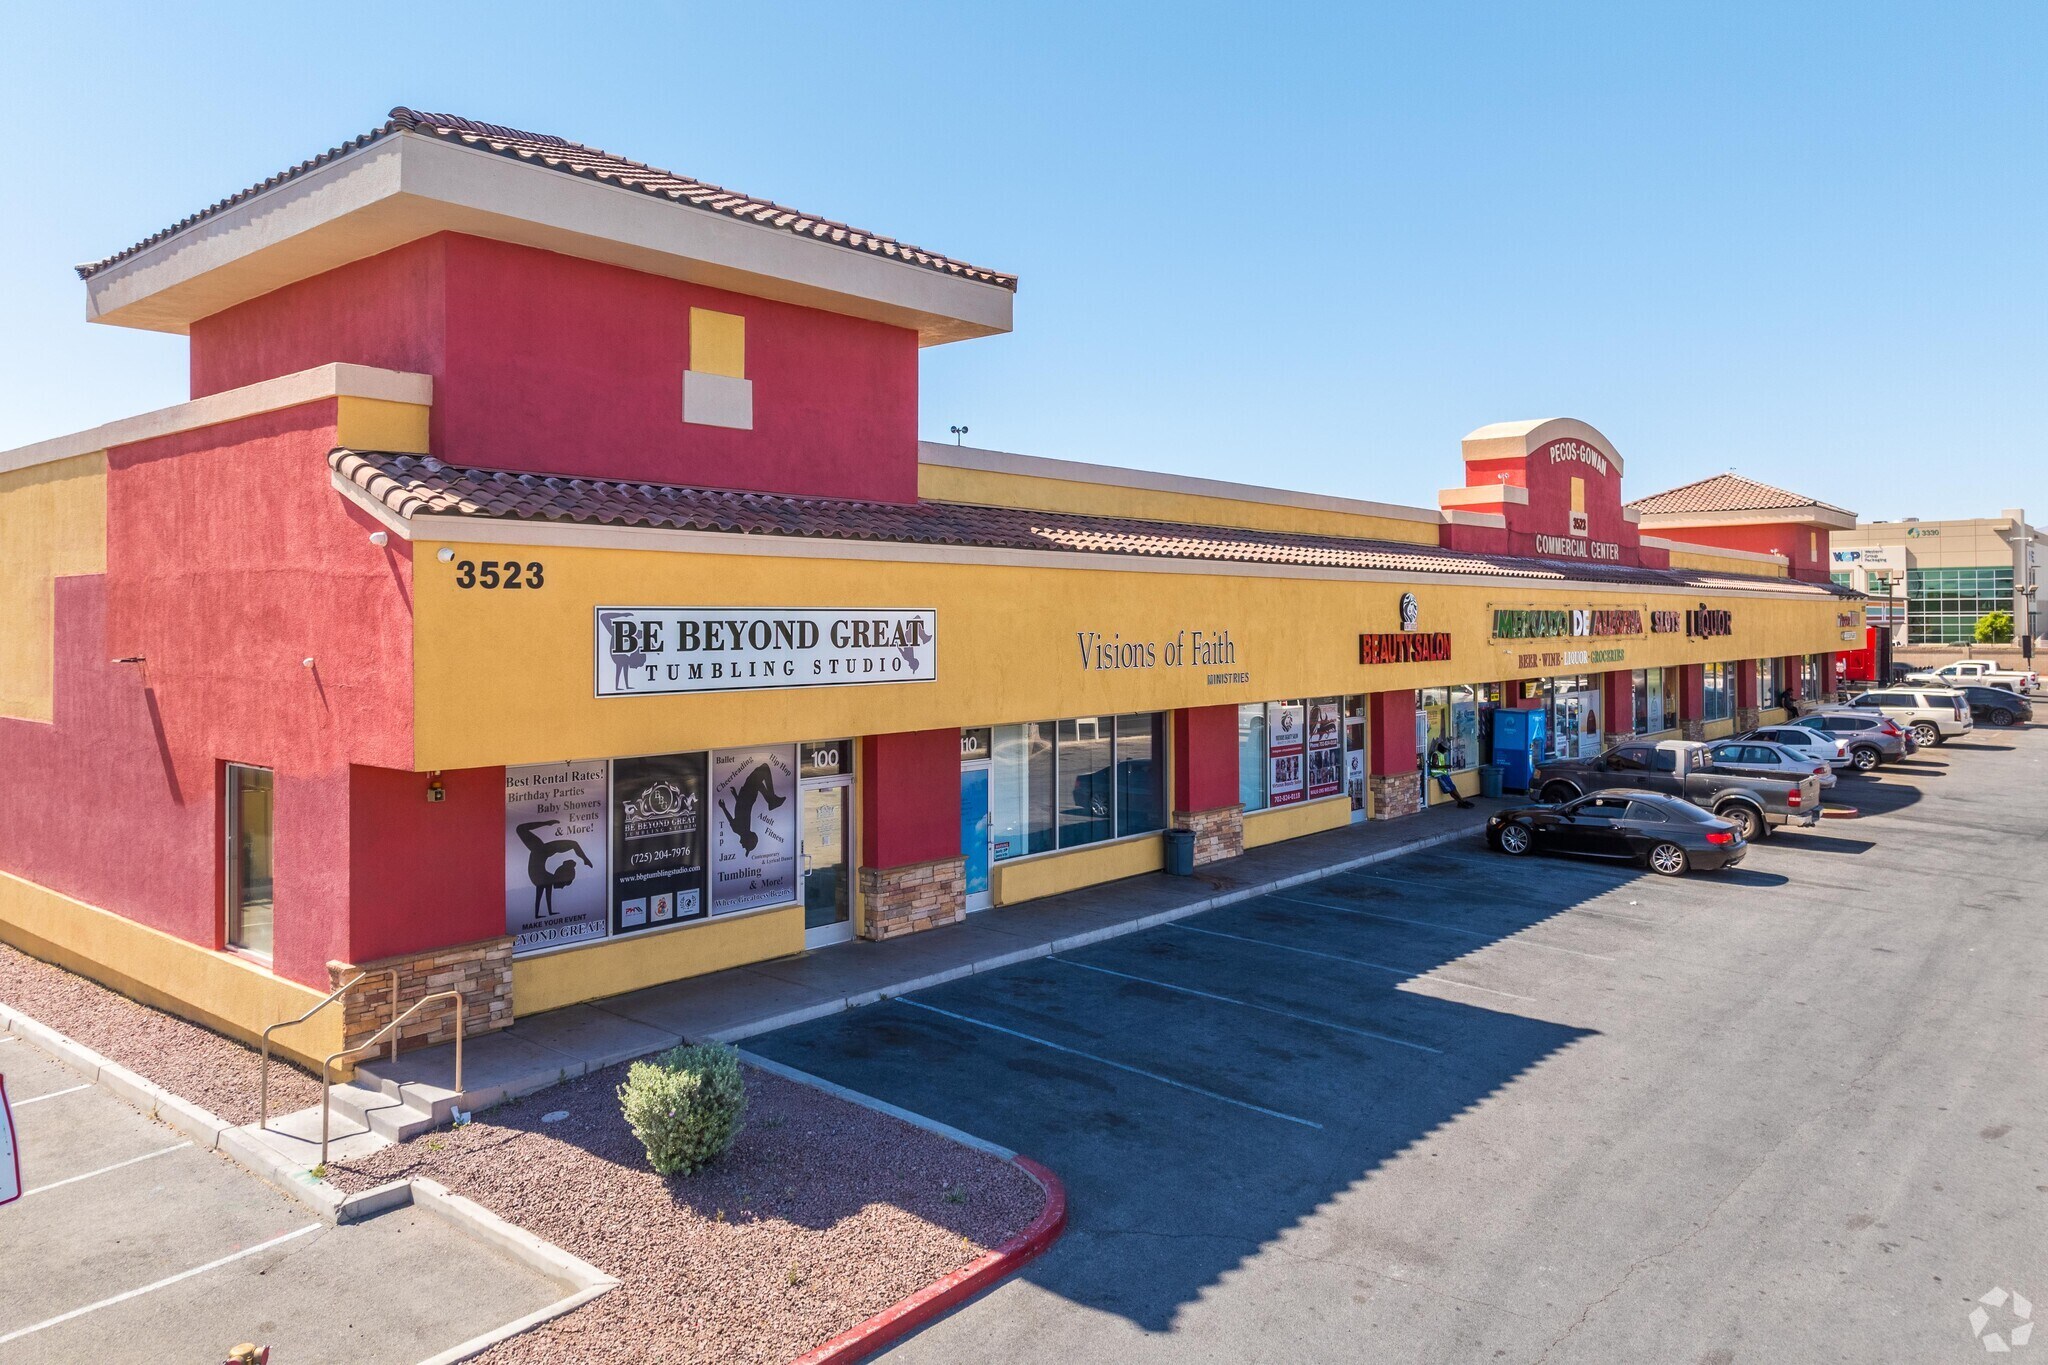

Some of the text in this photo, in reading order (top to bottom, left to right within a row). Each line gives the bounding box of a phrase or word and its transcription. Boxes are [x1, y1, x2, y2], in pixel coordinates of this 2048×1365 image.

[1550, 442, 1607, 477] PECOS-GOWAN
[1536, 534, 1619, 560] COMMERCIAL CENTER
[1833, 551, 1861, 562] WGP
[456, 560, 545, 590] 3523
[1571, 609, 1590, 637] DE
[1686, 608, 1732, 638] LIQUOR
[612, 619, 925, 654] BE BEYOND GREAT
[1077, 629, 1236, 671] Visions of Faith
[1360, 632, 1451, 664] BEAUTY SALON
[1518, 648, 1625, 669] BEER WINE LIQUOR GROCERIES
[645, 657, 902, 682] TUMBLING STUDIO
[1207, 672, 1250, 686] MINISTRIES
[716, 755, 735, 765] Ballet
[768, 753, 792, 777] Hip Hop
[811, 749, 839, 768] 100
[506, 768, 604, 788] Best Rental Rates!
[716, 756, 754, 793] Cheerleading
[508, 786, 585, 803] Birthday Parties
[537, 799, 602, 815] Baby Showers
[569, 811, 599, 822] Events
[624, 815, 696, 832] BE BEYOND GREAT
[757, 812, 775, 826] Adult
[554, 822, 594, 837] & More!
[764, 827, 785, 844] Fitness
[630, 846, 691, 866] (725) 204-7976
[718, 852, 736, 862] Jazz
[619, 865, 701, 884] www.bbgtumblingstudio.com
[717, 867, 762, 882] Tumbling
[749, 876, 784, 890] & More!
[714, 897, 736, 907] Where
[522, 913, 587, 931] MAKE YOUR EVENT
[560, 920, 606, 938] GREAT!
